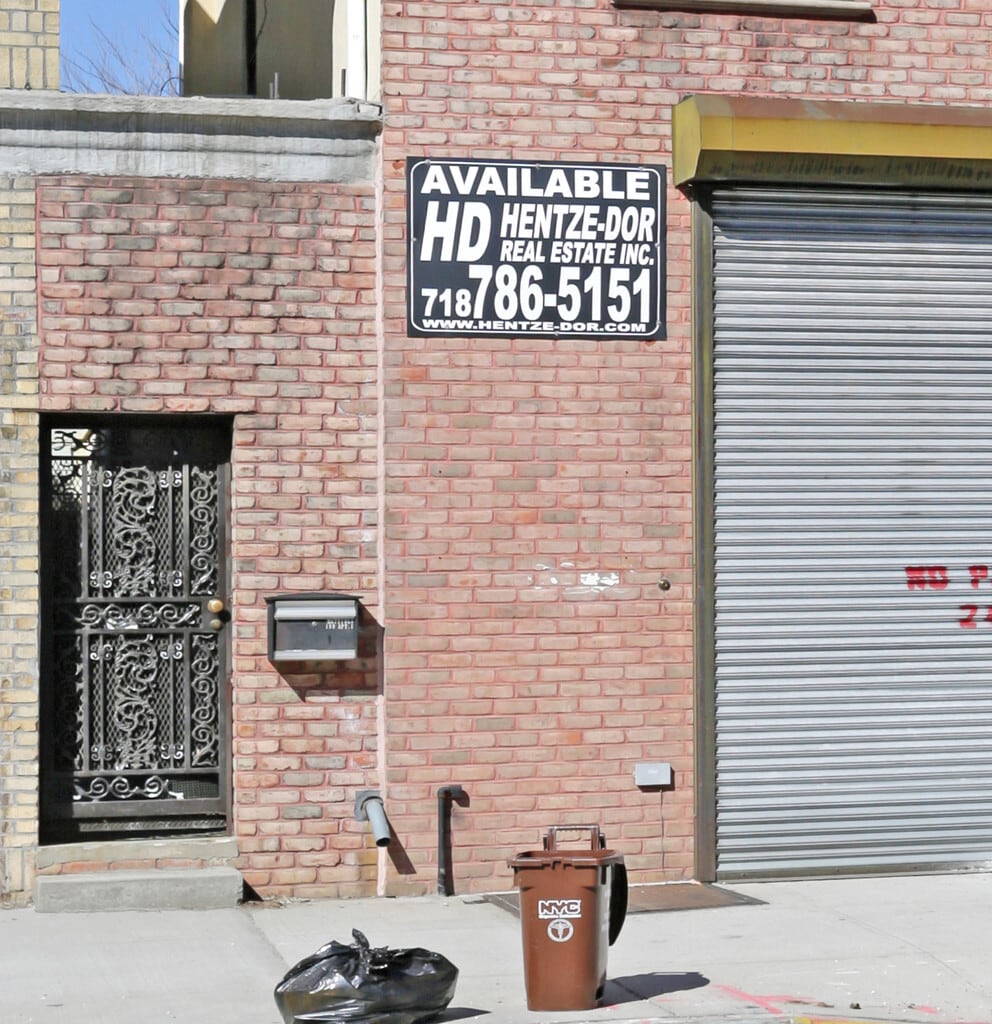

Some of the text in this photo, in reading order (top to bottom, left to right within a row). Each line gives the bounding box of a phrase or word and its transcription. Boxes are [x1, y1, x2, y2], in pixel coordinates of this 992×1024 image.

[420, 165, 650, 200] AVAILABLE
[420, 201, 492, 262] HD
[500, 203, 656, 242] HENTZE-DOR
[500, 242, 655, 266] REAL ESTATE INC.
[421, 264, 650, 323] 718 786-5151
[421, 319, 647, 333] WWW.HENTZE-DOR.COM
[905, 565, 949, 590] NO
[538, 899, 582, 915] NYC
